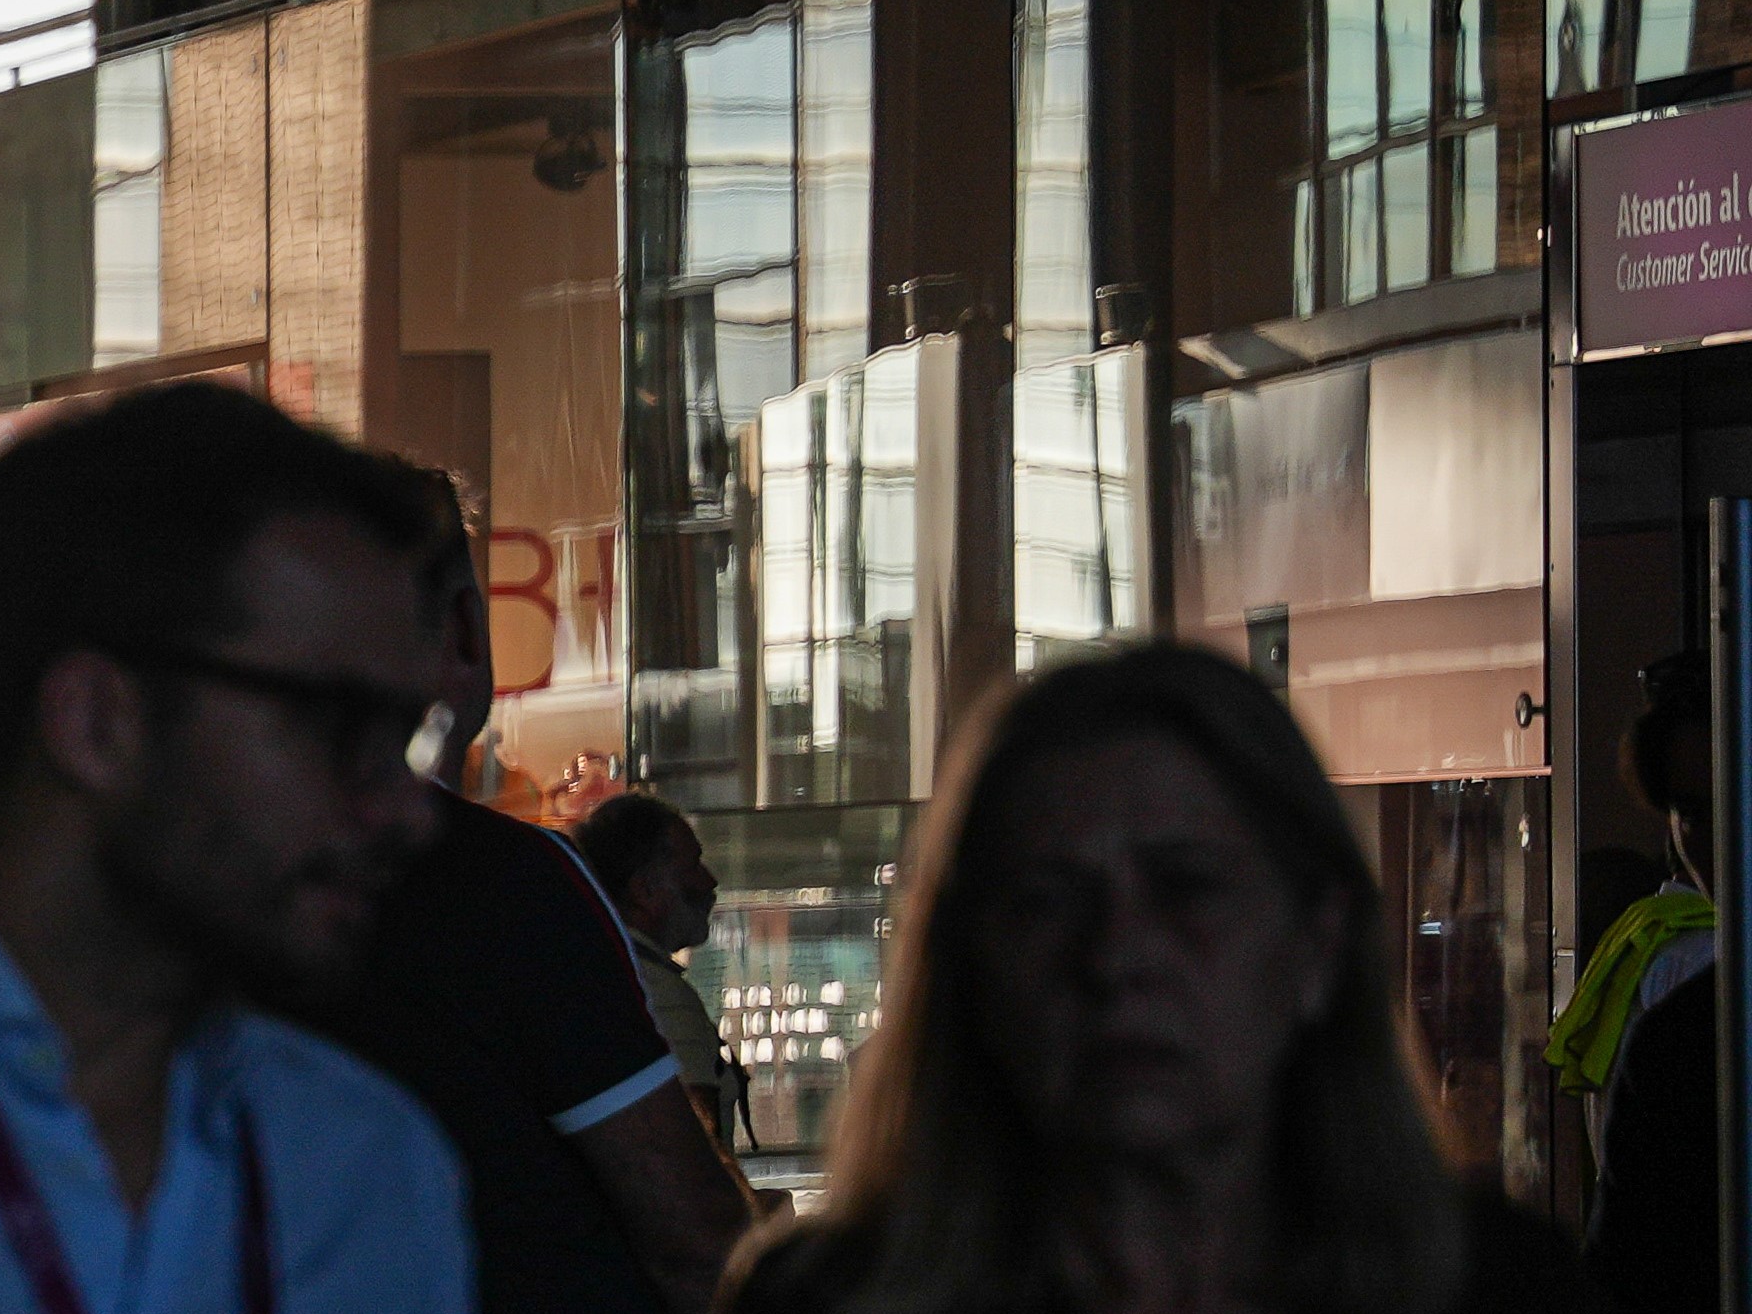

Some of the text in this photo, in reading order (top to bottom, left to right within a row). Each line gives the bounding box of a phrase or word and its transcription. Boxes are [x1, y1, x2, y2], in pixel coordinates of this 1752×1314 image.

[1616, 178, 1711, 239] Atención
[1720, 171, 1740, 223] al
[1616, 252, 1694, 292] Customer
